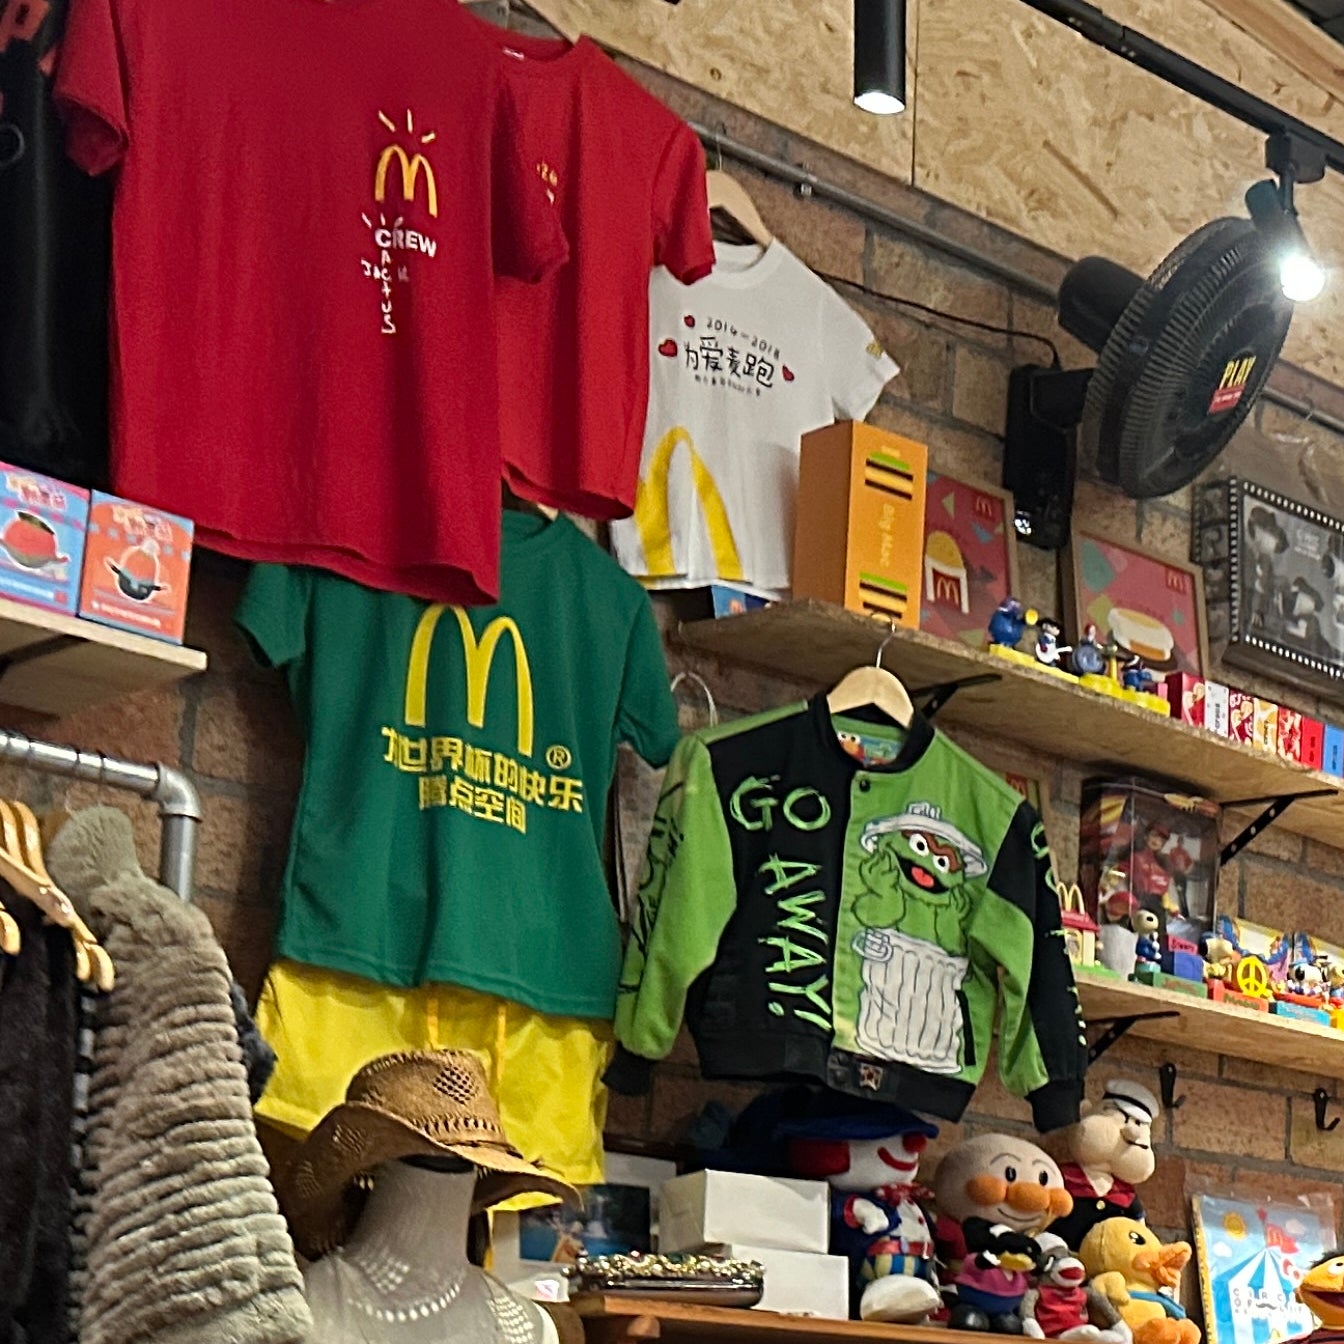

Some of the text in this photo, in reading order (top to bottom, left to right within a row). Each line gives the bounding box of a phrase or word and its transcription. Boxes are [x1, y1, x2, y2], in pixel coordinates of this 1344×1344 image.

[375, 228, 437, 258] CREW
[684, 336, 775, 388] 为爱麦跑
[730, 774, 833, 832] GO
[757, 852, 833, 1032] AWAY!
